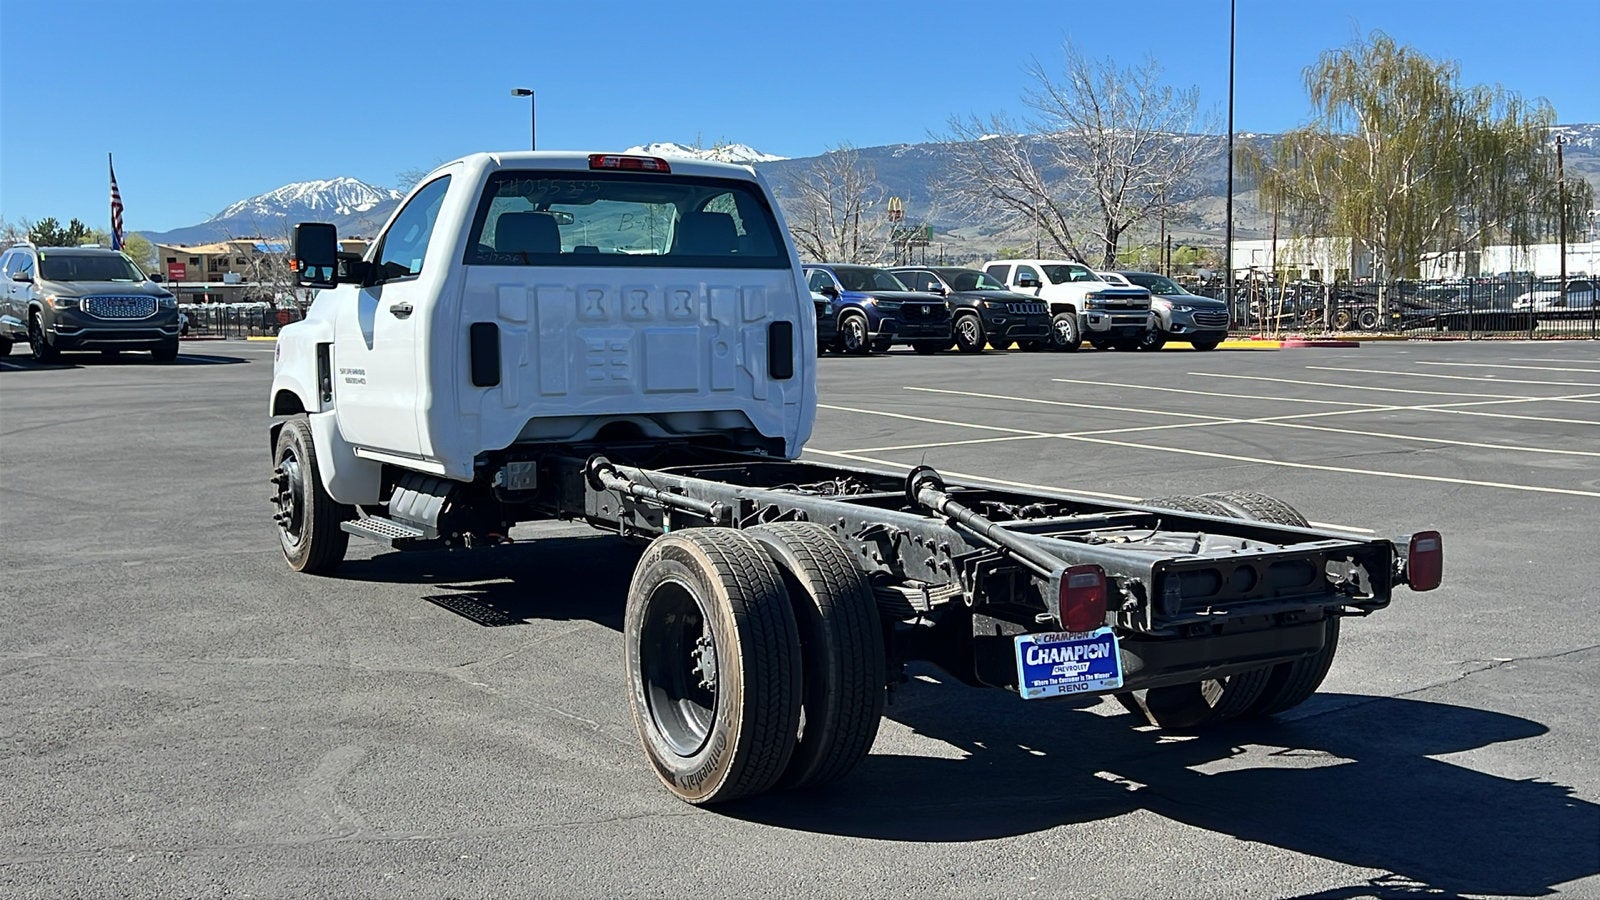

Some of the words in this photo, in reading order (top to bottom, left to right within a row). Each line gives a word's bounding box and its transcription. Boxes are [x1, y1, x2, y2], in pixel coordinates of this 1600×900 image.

[1043, 631, 1089, 643] CHAMPION
[1026, 643, 1110, 666] CHAMPION
[1054, 664, 1088, 673] CHEVROLET
[1058, 683, 1089, 694] RENO
[686, 729, 727, 793] Continental
